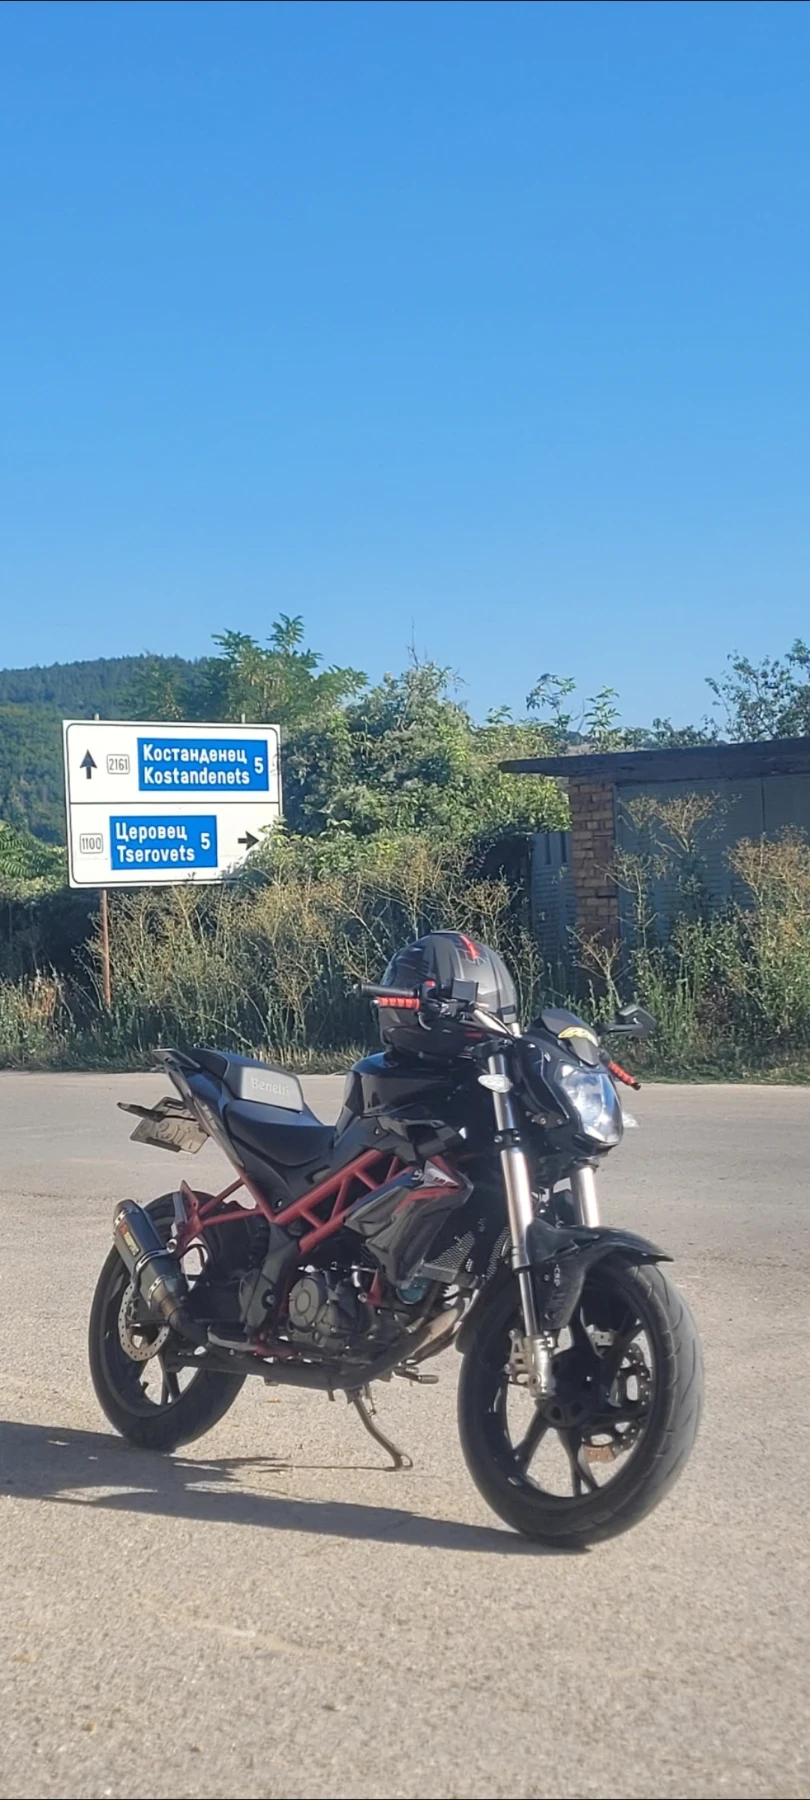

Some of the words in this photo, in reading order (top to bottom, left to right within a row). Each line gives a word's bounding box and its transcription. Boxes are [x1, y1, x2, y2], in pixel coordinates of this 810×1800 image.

[143, 744, 247, 764] Костанденец
[108, 758, 128, 771] 2161
[254, 757, 264, 774] 5
[144, 767, 250, 785] Kostandenets
[115, 822, 188, 843] Церовец
[200, 833, 211, 850] 5
[81, 837, 101, 850] 1100
[117, 845, 195, 863] Tserovets
[251, 1078, 289, 1096] Benelli
